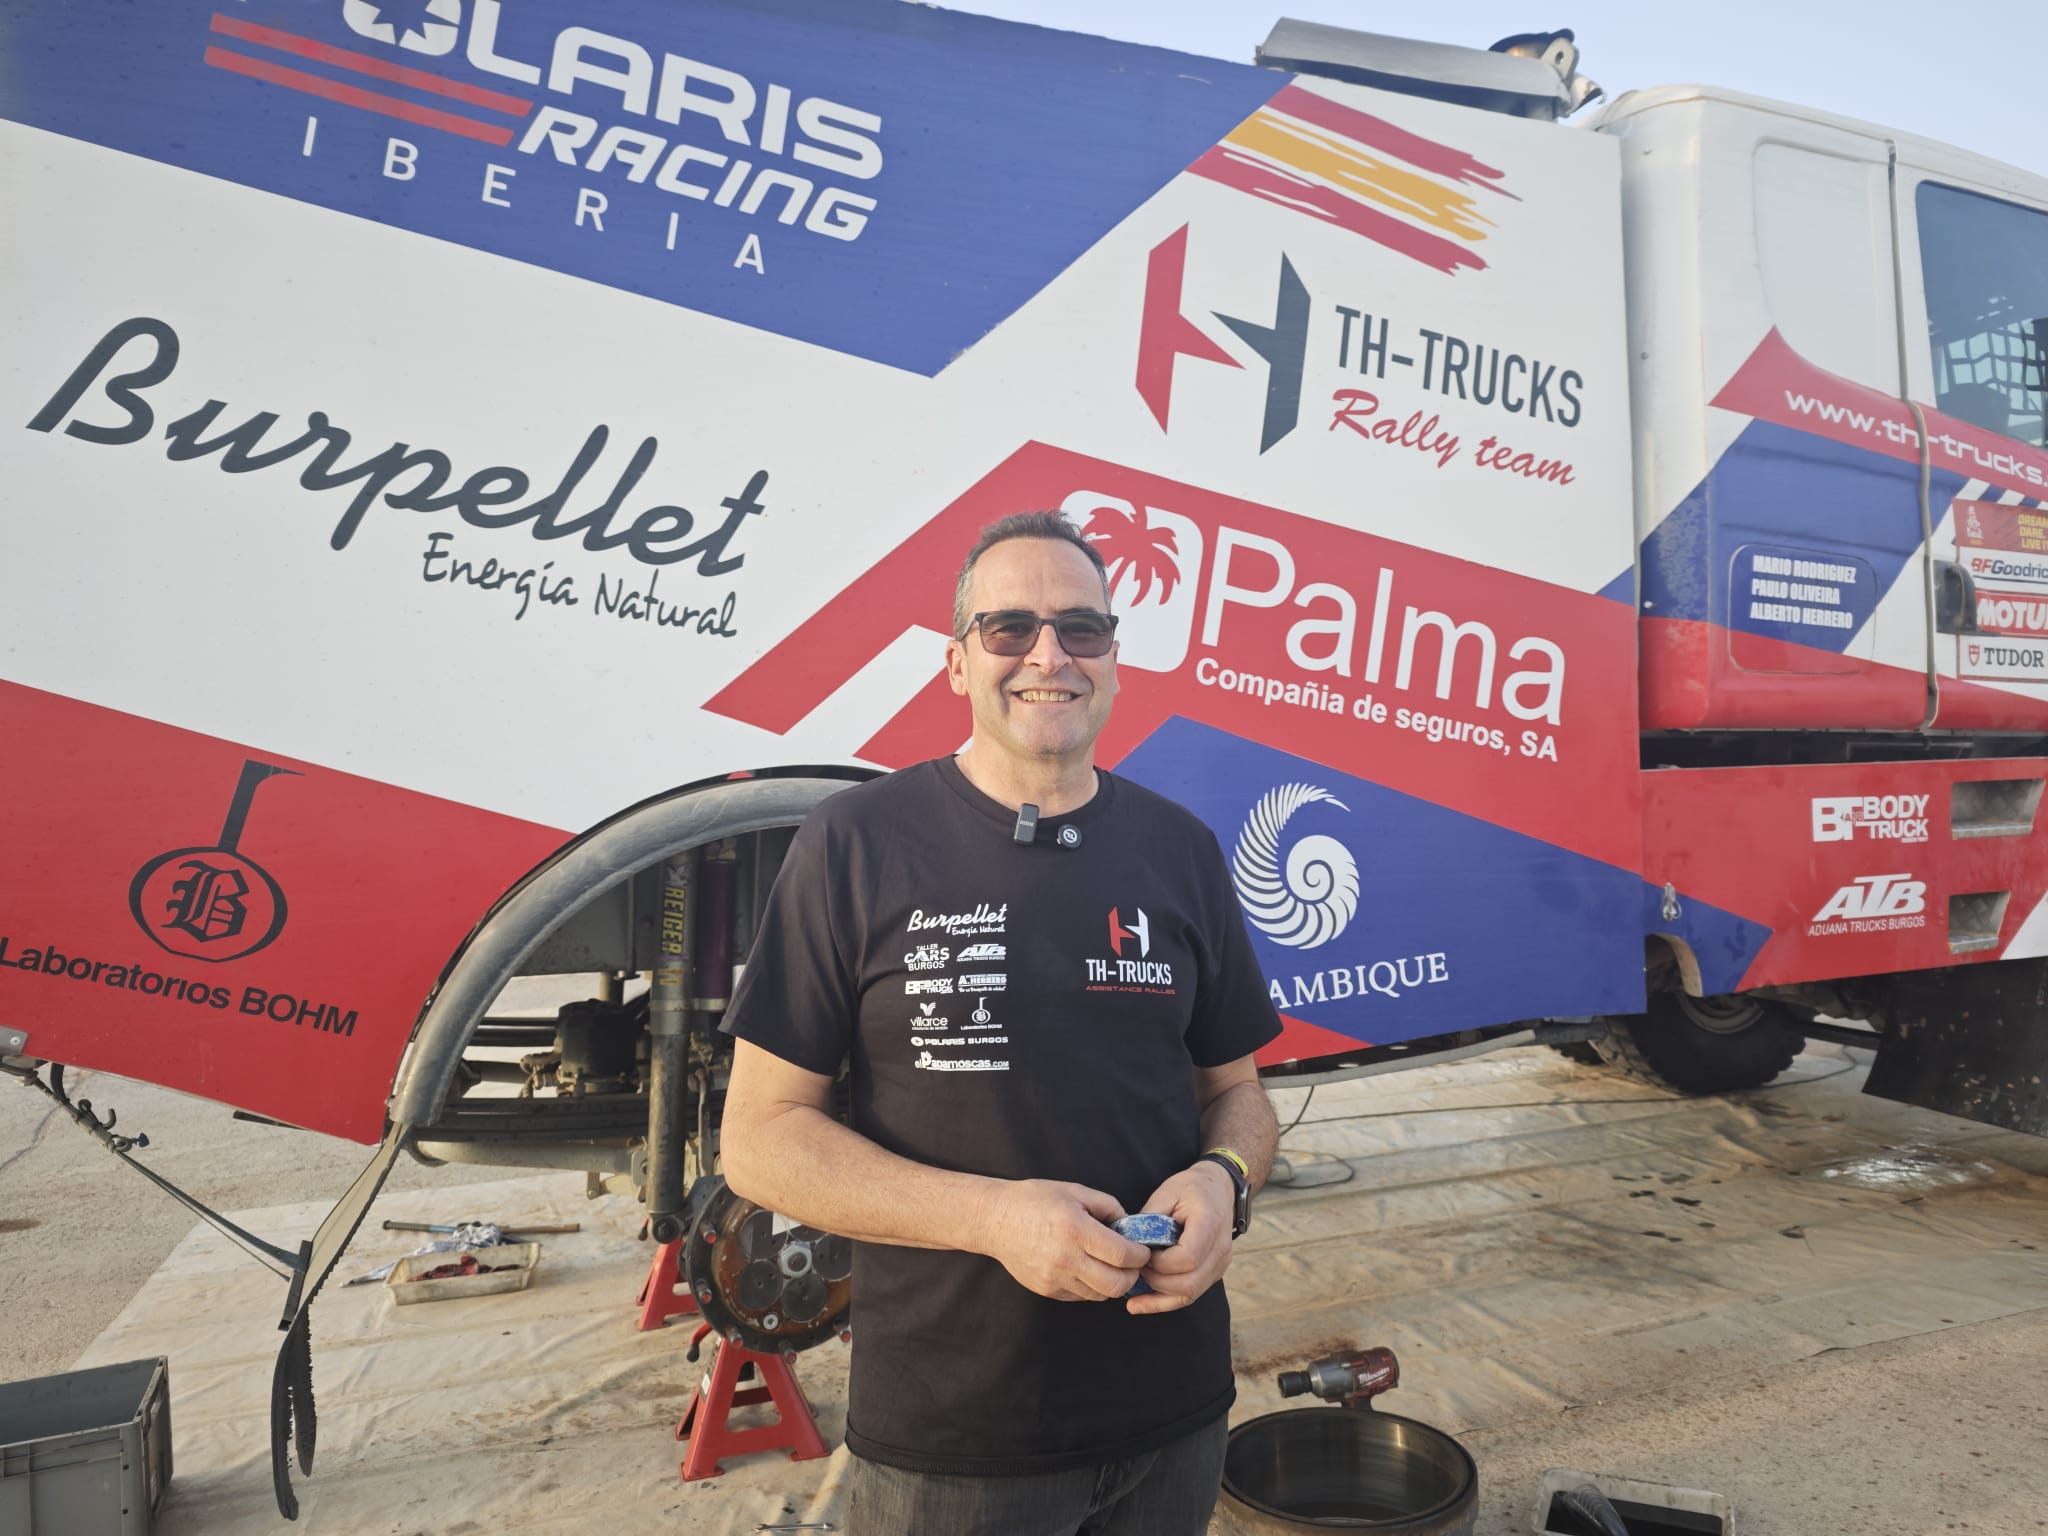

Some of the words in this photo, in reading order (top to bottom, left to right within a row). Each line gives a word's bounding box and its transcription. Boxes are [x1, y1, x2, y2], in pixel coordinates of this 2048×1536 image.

[240, 0, 883, 180] OLARIS
[518, 106, 877, 241] RACING
[303, 117, 764, 274] IBERIA
[1335, 305, 1583, 428] TH-TRUCKS
[25, 317, 769, 577] Burpellet
[1329, 388, 1460, 468] Rally
[1475, 436, 1575, 485] team
[423, 532, 578, 620] Energía
[594, 569, 737, 638] Natural
[1753, 555, 1792, 576] MARIO
[1793, 560, 1856, 584] RODRIGUEZ
[1752, 578, 1788, 599] PAULO
[1790, 583, 1840, 605] OLIVEIRA
[1202, 525, 1565, 726] Palma
[1750, 602, 1800, 623] ALBERTO
[1802, 607, 1853, 629] HERRERO
[1977, 598, 2048, 631] MOTU
[1984, 647, 2044, 668] TUDOR
[1353, 694, 1387, 723] de
[1395, 708, 1510, 756] seguros,
[1519, 730, 1558, 762] SA
[1864, 794, 1930, 820] BODY
[1862, 819, 1929, 840] TRUCK
[1812, 873, 1926, 922] ATB
[662, 887, 685, 955] REIGER
[907, 903, 1007, 934] Burpellet
[1808, 922, 1848, 936] ADUANA
[1850, 918, 1886, 933] TRUCKS
[1888, 915, 1925, 930] BURGOS
[916, 943, 938, 951] TALLER
[908, 960, 945, 971] BURGOS
[1085, 959, 1172, 985] TH-TRUCKS
[1269, 952, 1449, 1009] AMBIQUE
[0, 936, 231, 1009] Laboratorios
[239, 987, 358, 1037] BOHM
[925, 978, 953, 988] BODY
[910, 1016, 948, 1027] villarce
[967, 1036, 1009, 1045] BURGOS
